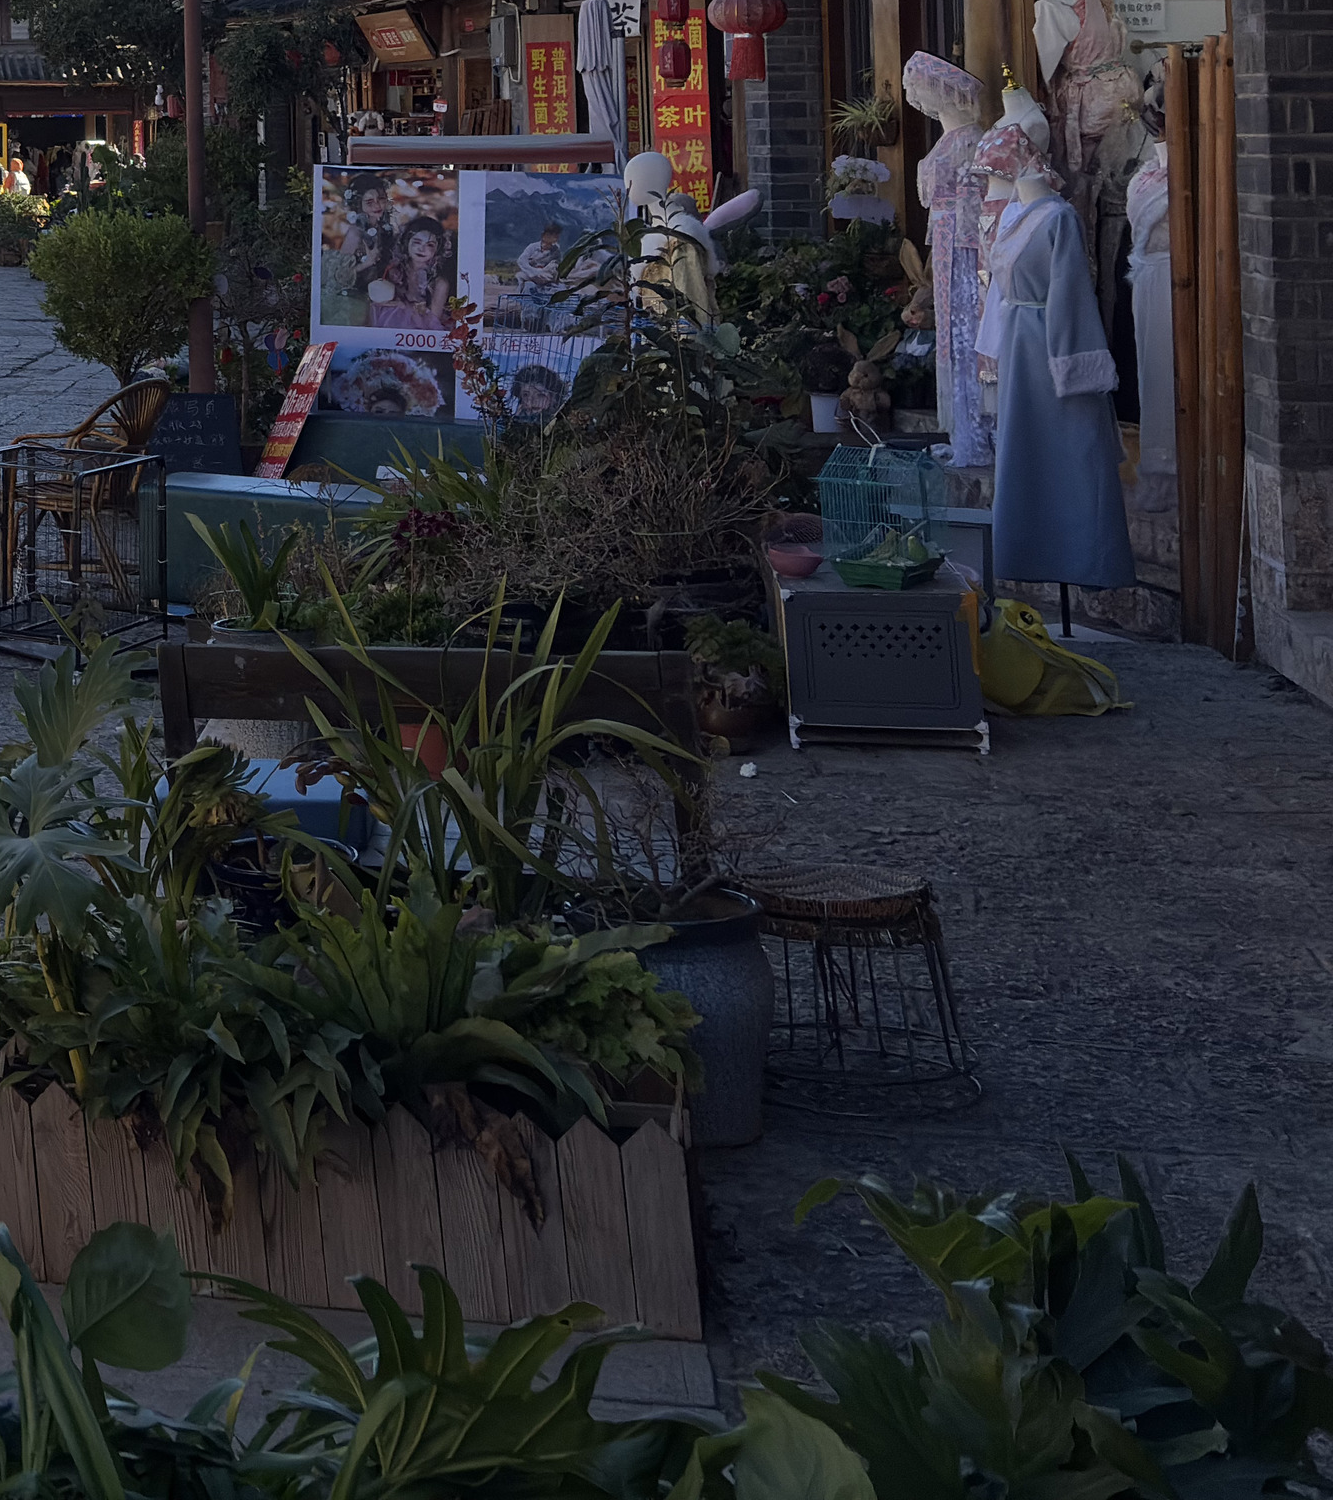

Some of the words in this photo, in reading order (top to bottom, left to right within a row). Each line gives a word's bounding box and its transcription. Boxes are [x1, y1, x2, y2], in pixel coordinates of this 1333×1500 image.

[531, 48, 548, 125] 野生菌
[551, 47, 569, 125] 普洱茶
[657, 104, 707, 129] 茶叶
[661, 138, 708, 175] 代发
